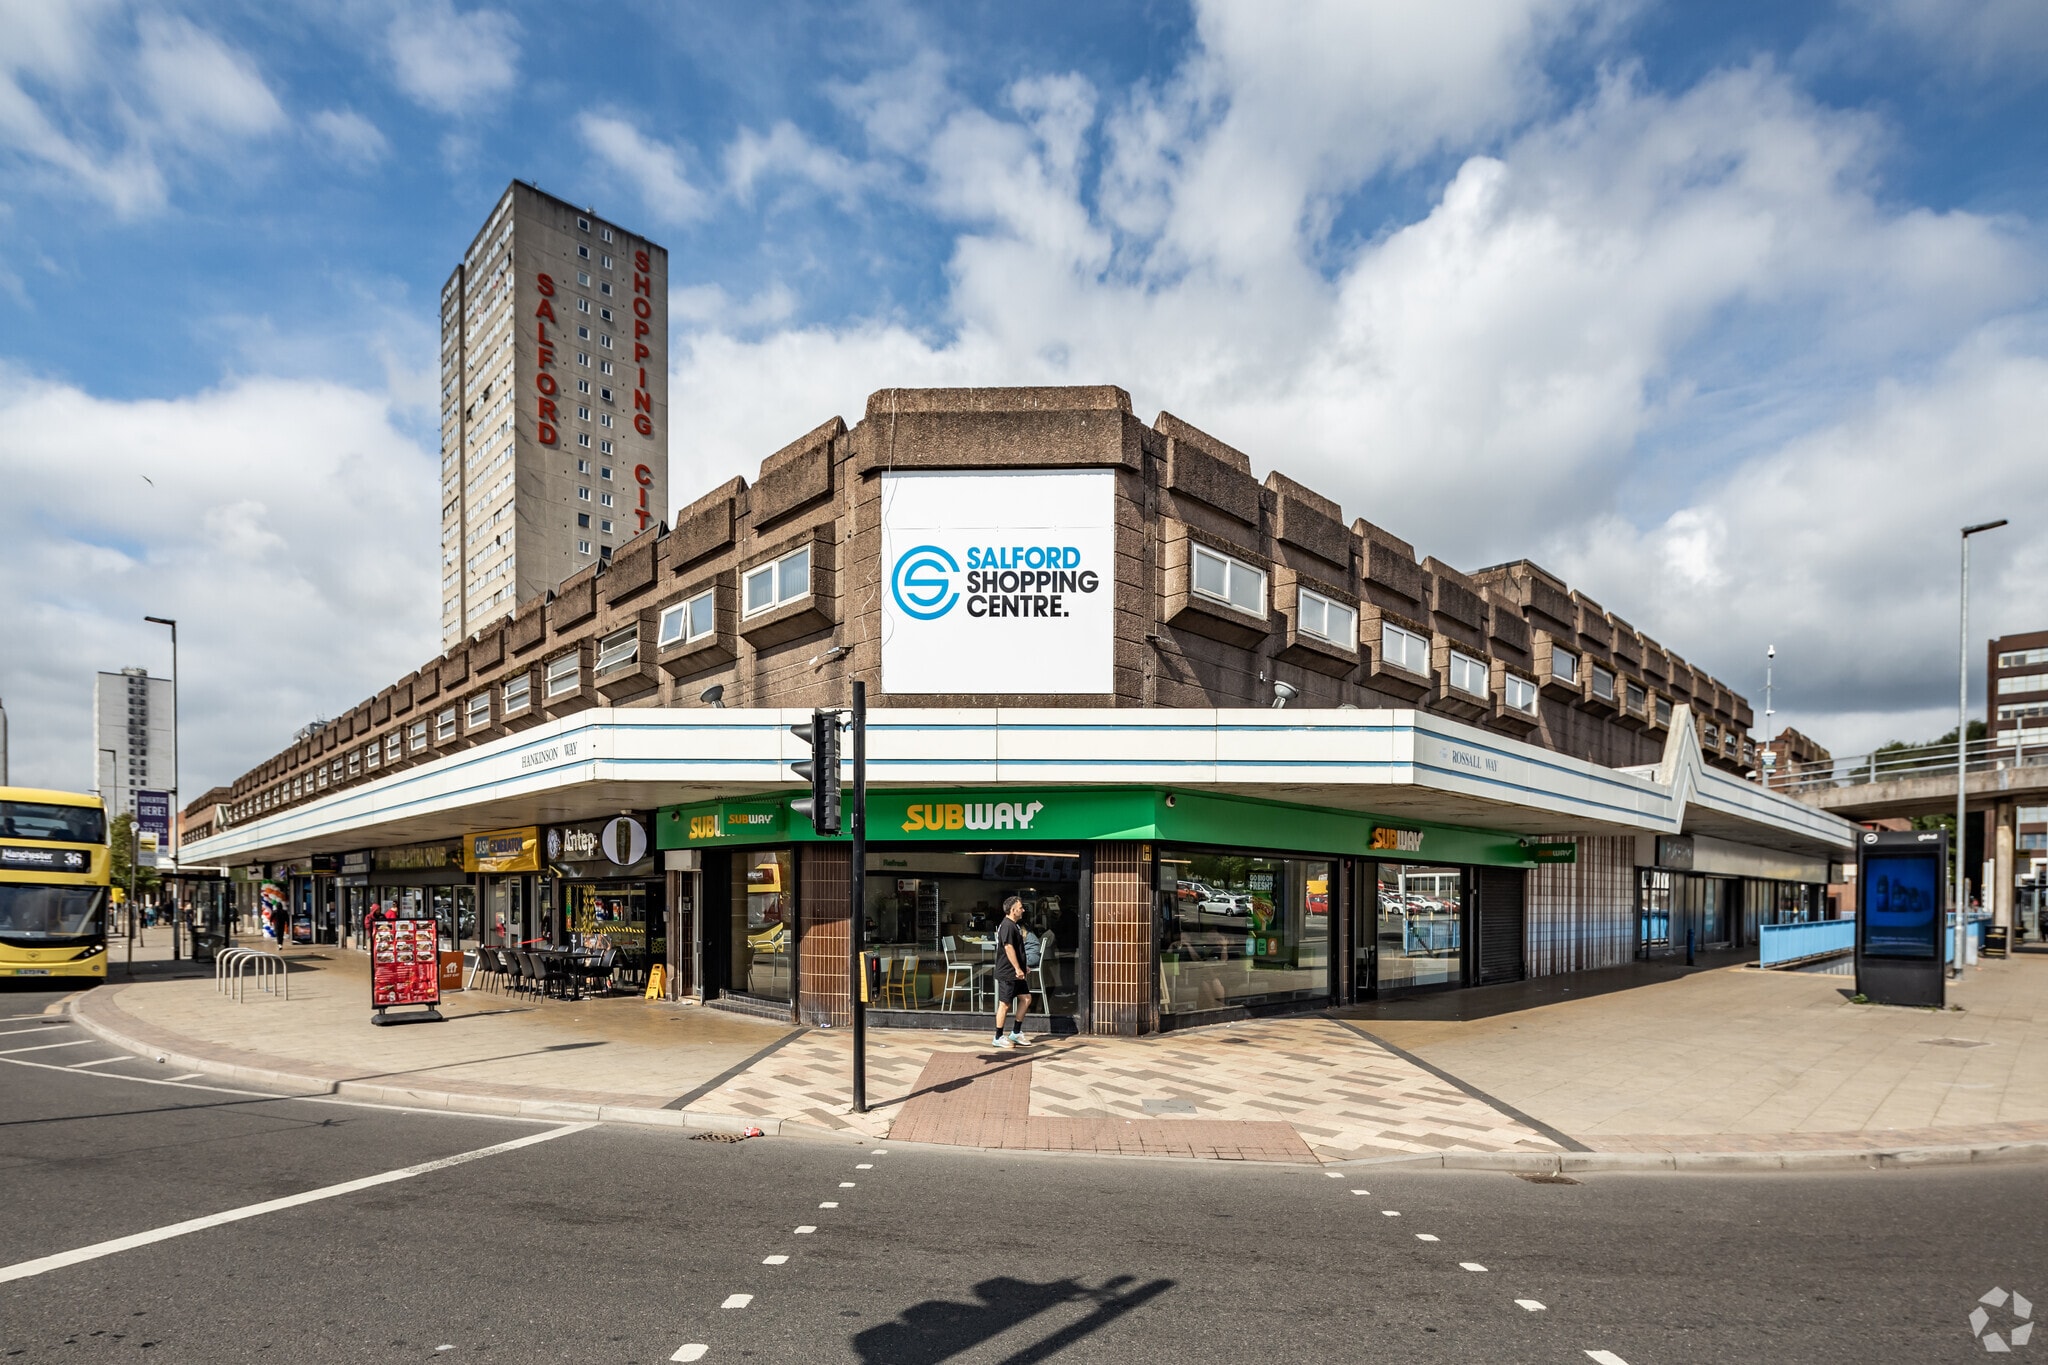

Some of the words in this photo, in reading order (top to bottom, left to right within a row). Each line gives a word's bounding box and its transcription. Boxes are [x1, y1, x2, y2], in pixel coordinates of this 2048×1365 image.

[633, 249, 652, 436] SHOPPING
[535, 273, 556, 445] SALFORD
[633, 464, 652, 535] CIT
[966, 546, 1081, 569] SALFORD
[966, 570, 1099, 594] SHOPPING
[966, 595, 1070, 618] CENTRE.
[521, 746, 559, 769] HANKINSON
[564, 741, 578, 757] WAY
[1452, 750, 1482, 769] ROSSALL
[1485, 758, 1499, 772] WAY
[140, 805, 166, 817] HERE!
[728, 813, 774, 824] SUBWAY
[901, 800, 1044, 833] SUBWAY
[689, 814, 735, 840] SUB
[475, 840, 489, 855] CASH
[489, 836, 523, 852] GENERATOR
[1368, 827, 1424, 852] SUBWAY
[1, 848, 53, 861] Manchester
[64, 852, 82, 866] 36
[1537, 849, 1572, 857] SUBWAY
[1249, 881, 1273, 891] FRESH?
